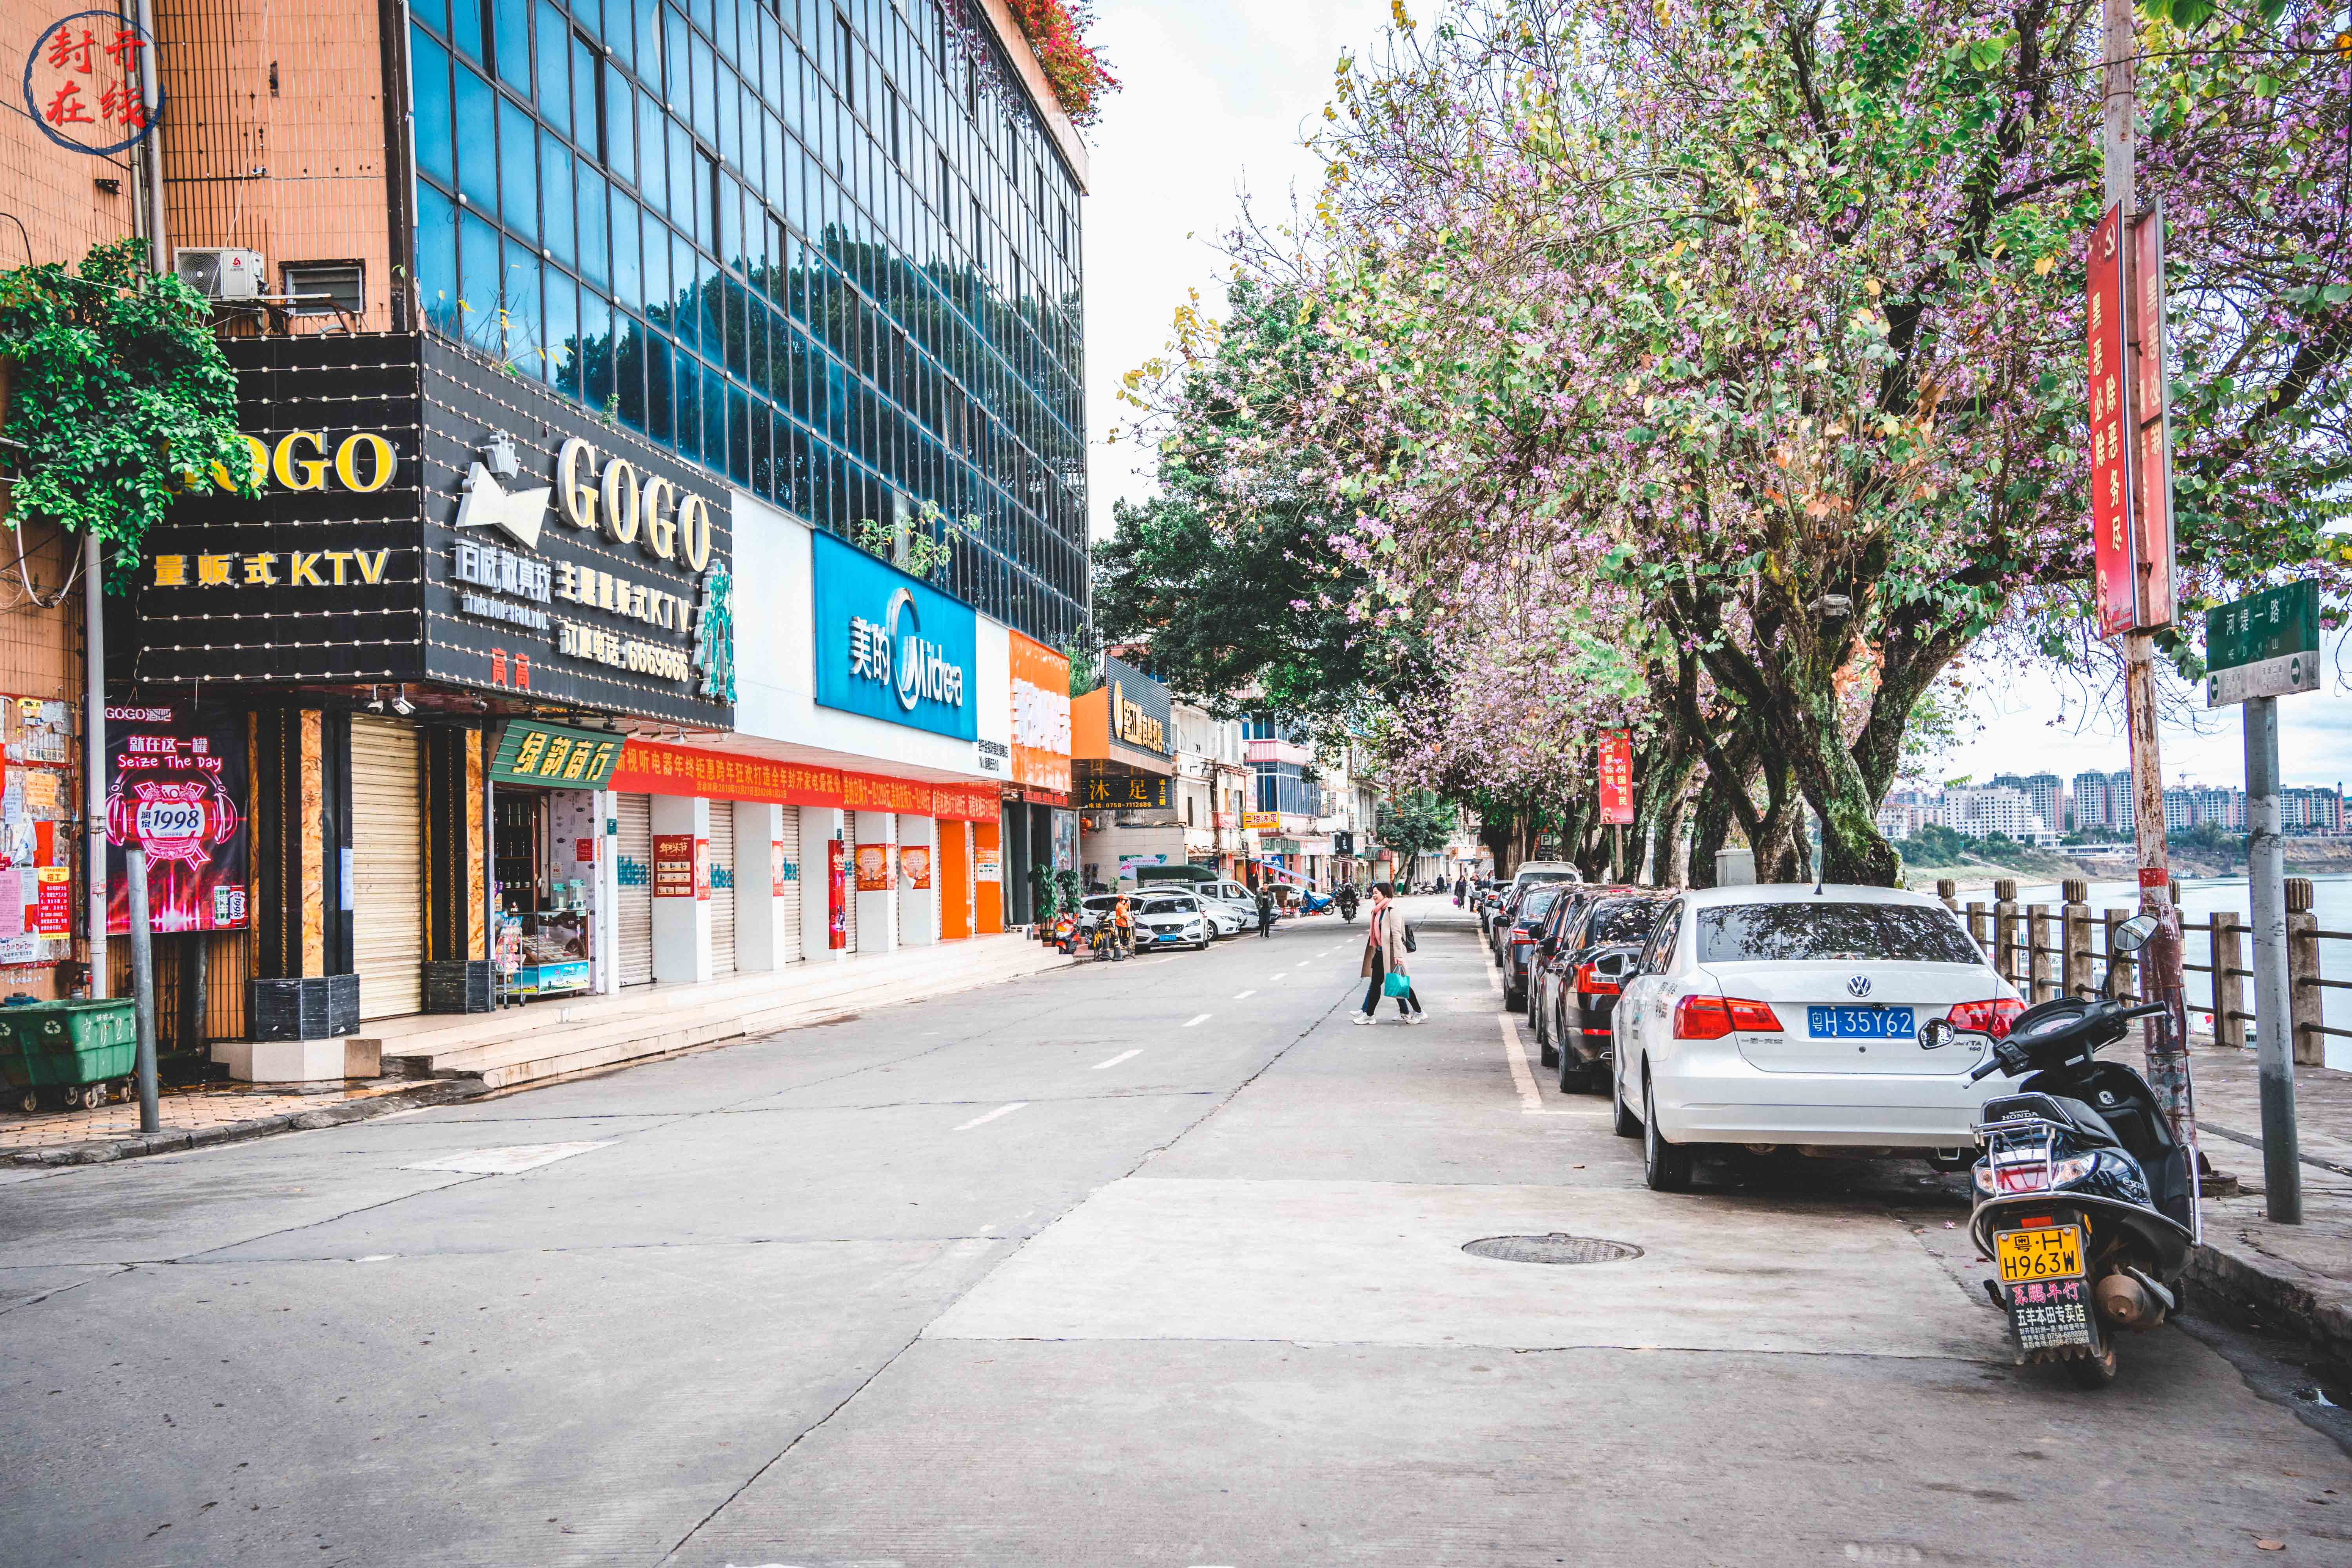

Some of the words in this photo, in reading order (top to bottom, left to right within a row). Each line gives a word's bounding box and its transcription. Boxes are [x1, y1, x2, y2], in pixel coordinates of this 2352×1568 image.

[2106, 374, 2123, 552] 除恶务尽
[557, 438, 710, 572] GOGO
[2226, 598, 2280, 636] 河堤一路
[849, 616, 890, 686] 美的
[902, 635, 963, 708] Midea
[129, 737, 209, 753] 就在这一罐
[513, 731, 614, 781] 绿韵商行
[119, 755, 159, 768] Seize
[164, 755, 192, 768] The
[198, 756, 223, 772] Day
[1089, 779, 1148, 800] 沐足
[141, 811, 151, 828] 漓泉
[153, 809, 200, 830] 1998
[1245, 814, 1277, 823] 二楼沐足
[2001, 1112, 2039, 1120] HONDA
[2004, 1250, 2076, 1279] H963W
[2012, 1279, 2079, 1306] 东鹏车行
[2016, 1303, 2086, 1327] 五羊本田专卖店
